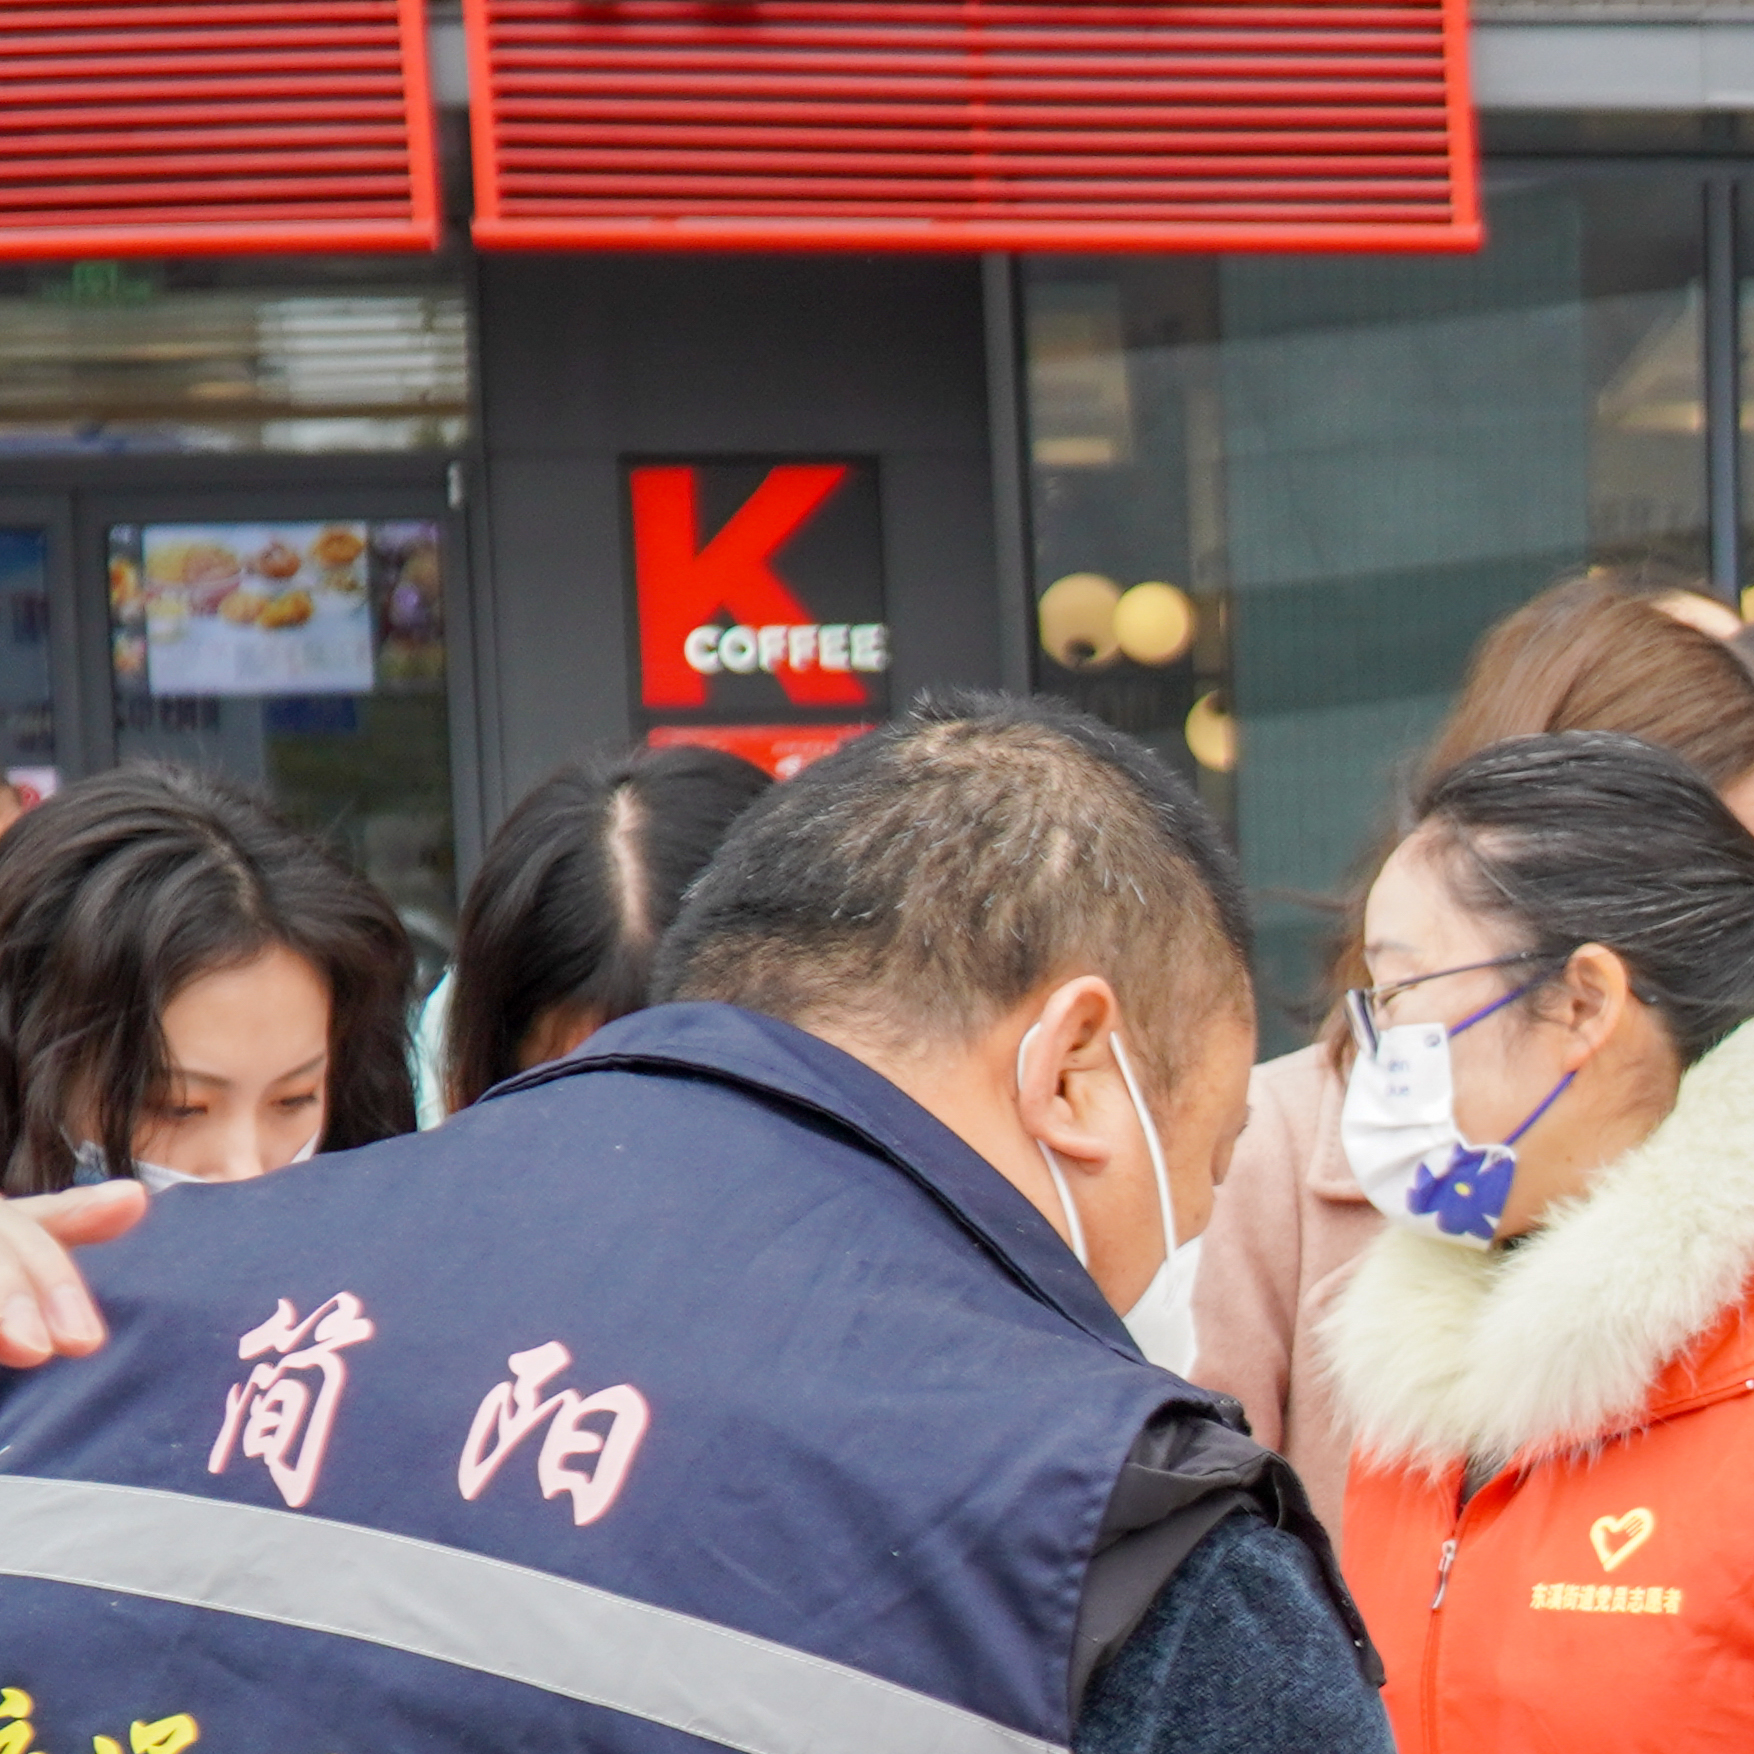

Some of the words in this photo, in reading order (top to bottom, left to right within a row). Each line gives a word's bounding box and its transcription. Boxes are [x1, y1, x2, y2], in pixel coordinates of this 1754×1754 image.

[630, 464, 868, 708] K
[684, 625, 890, 675] COFFEE
[207, 1290, 649, 1527] 简阳
